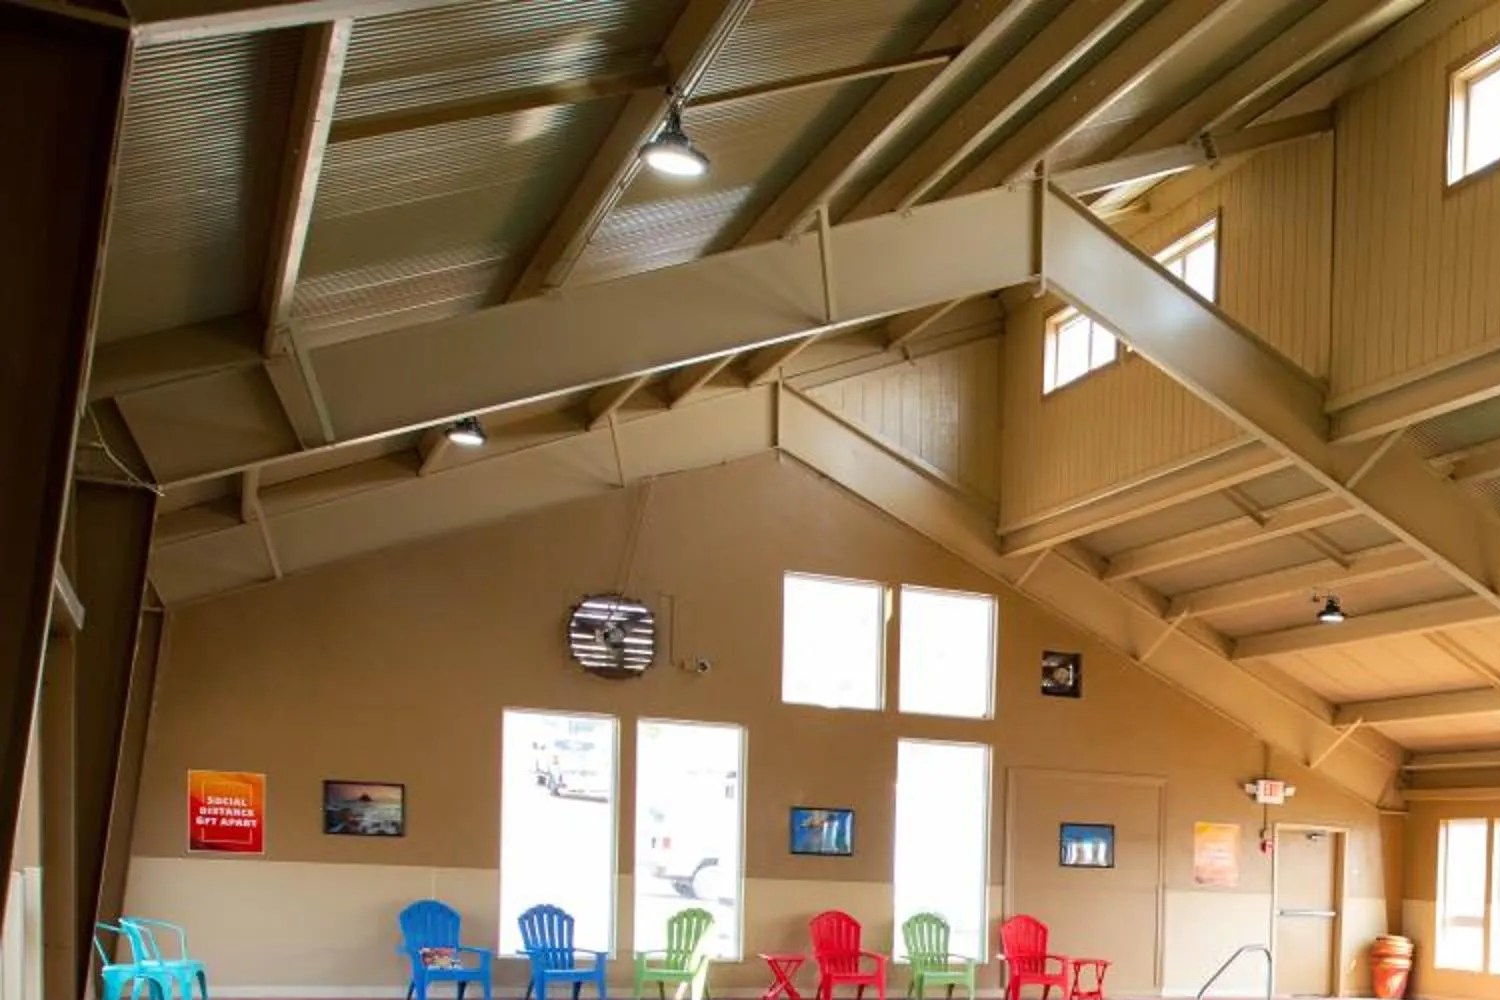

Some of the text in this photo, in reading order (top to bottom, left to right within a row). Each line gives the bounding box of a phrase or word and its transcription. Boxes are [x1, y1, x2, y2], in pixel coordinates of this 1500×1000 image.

[207, 796, 248, 807] SOCIAL
[199, 806, 255, 817] DISTANCE
[220, 818, 257, 828] APART
